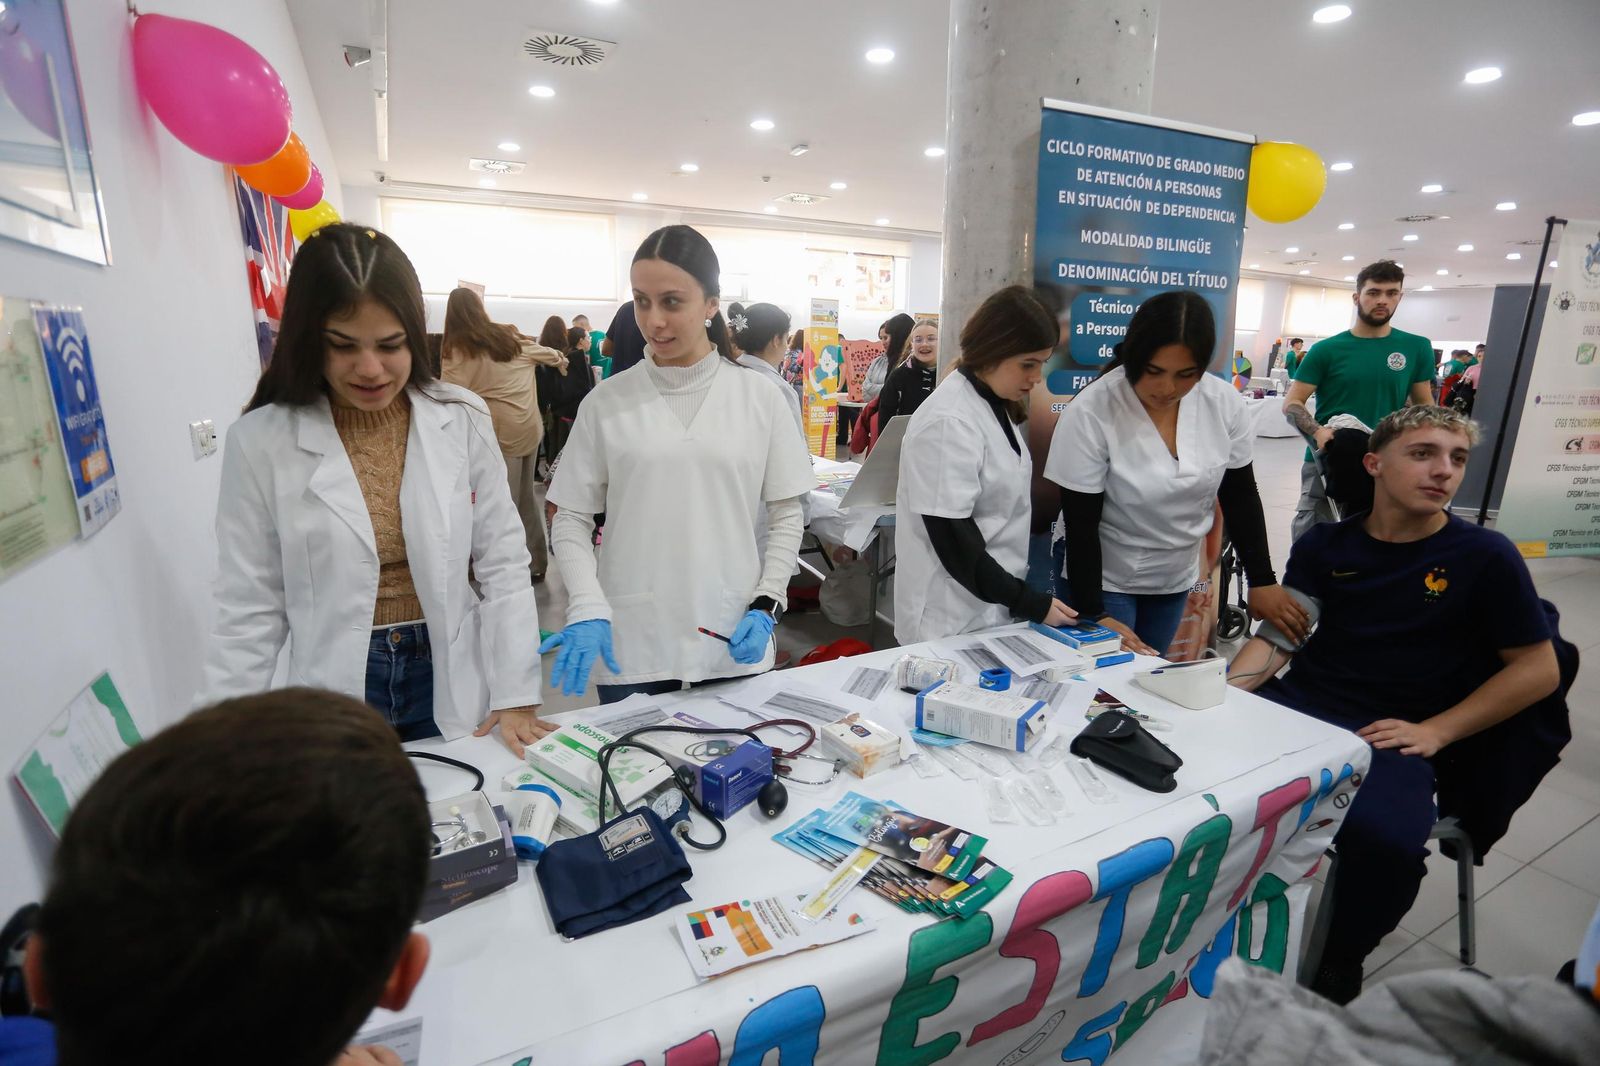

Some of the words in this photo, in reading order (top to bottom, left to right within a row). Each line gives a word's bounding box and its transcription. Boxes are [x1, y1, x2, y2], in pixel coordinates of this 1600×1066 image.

[1046, 139, 1084, 156] CICLO
[1087, 144, 1153, 167] FORMATIVO
[1156, 156, 1171, 170] DE
[1173, 158, 1211, 176] GRADO
[1213, 164, 1245, 181] MEDIO
[1077, 168, 1092, 183] DE
[1095, 169, 1152, 190] ATENCIÓN
[1154, 178, 1162, 191] A
[1165, 180, 1222, 199] PERSONAS
[1058, 190, 1075, 205] EN
[1078, 192, 1141, 212] SITUACIÓN
[1146, 201, 1160, 215] DE
[1163, 204, 1236, 224] DEPENDENCIA
[1081, 229, 1153, 250] MODALIDAD
[1155, 237, 1211, 254] BILINGÜE
[1058, 262, 1158, 284] DENOMINACIÓN
[1161, 272, 1184, 286] DEL
[1187, 268, 1228, 289] TÍTULO
[1089, 297, 1133, 314] Técnico
[1076, 324, 1083, 335] a
[1086, 321, 1129, 336] Person
[1098, 344, 1113, 358] de
